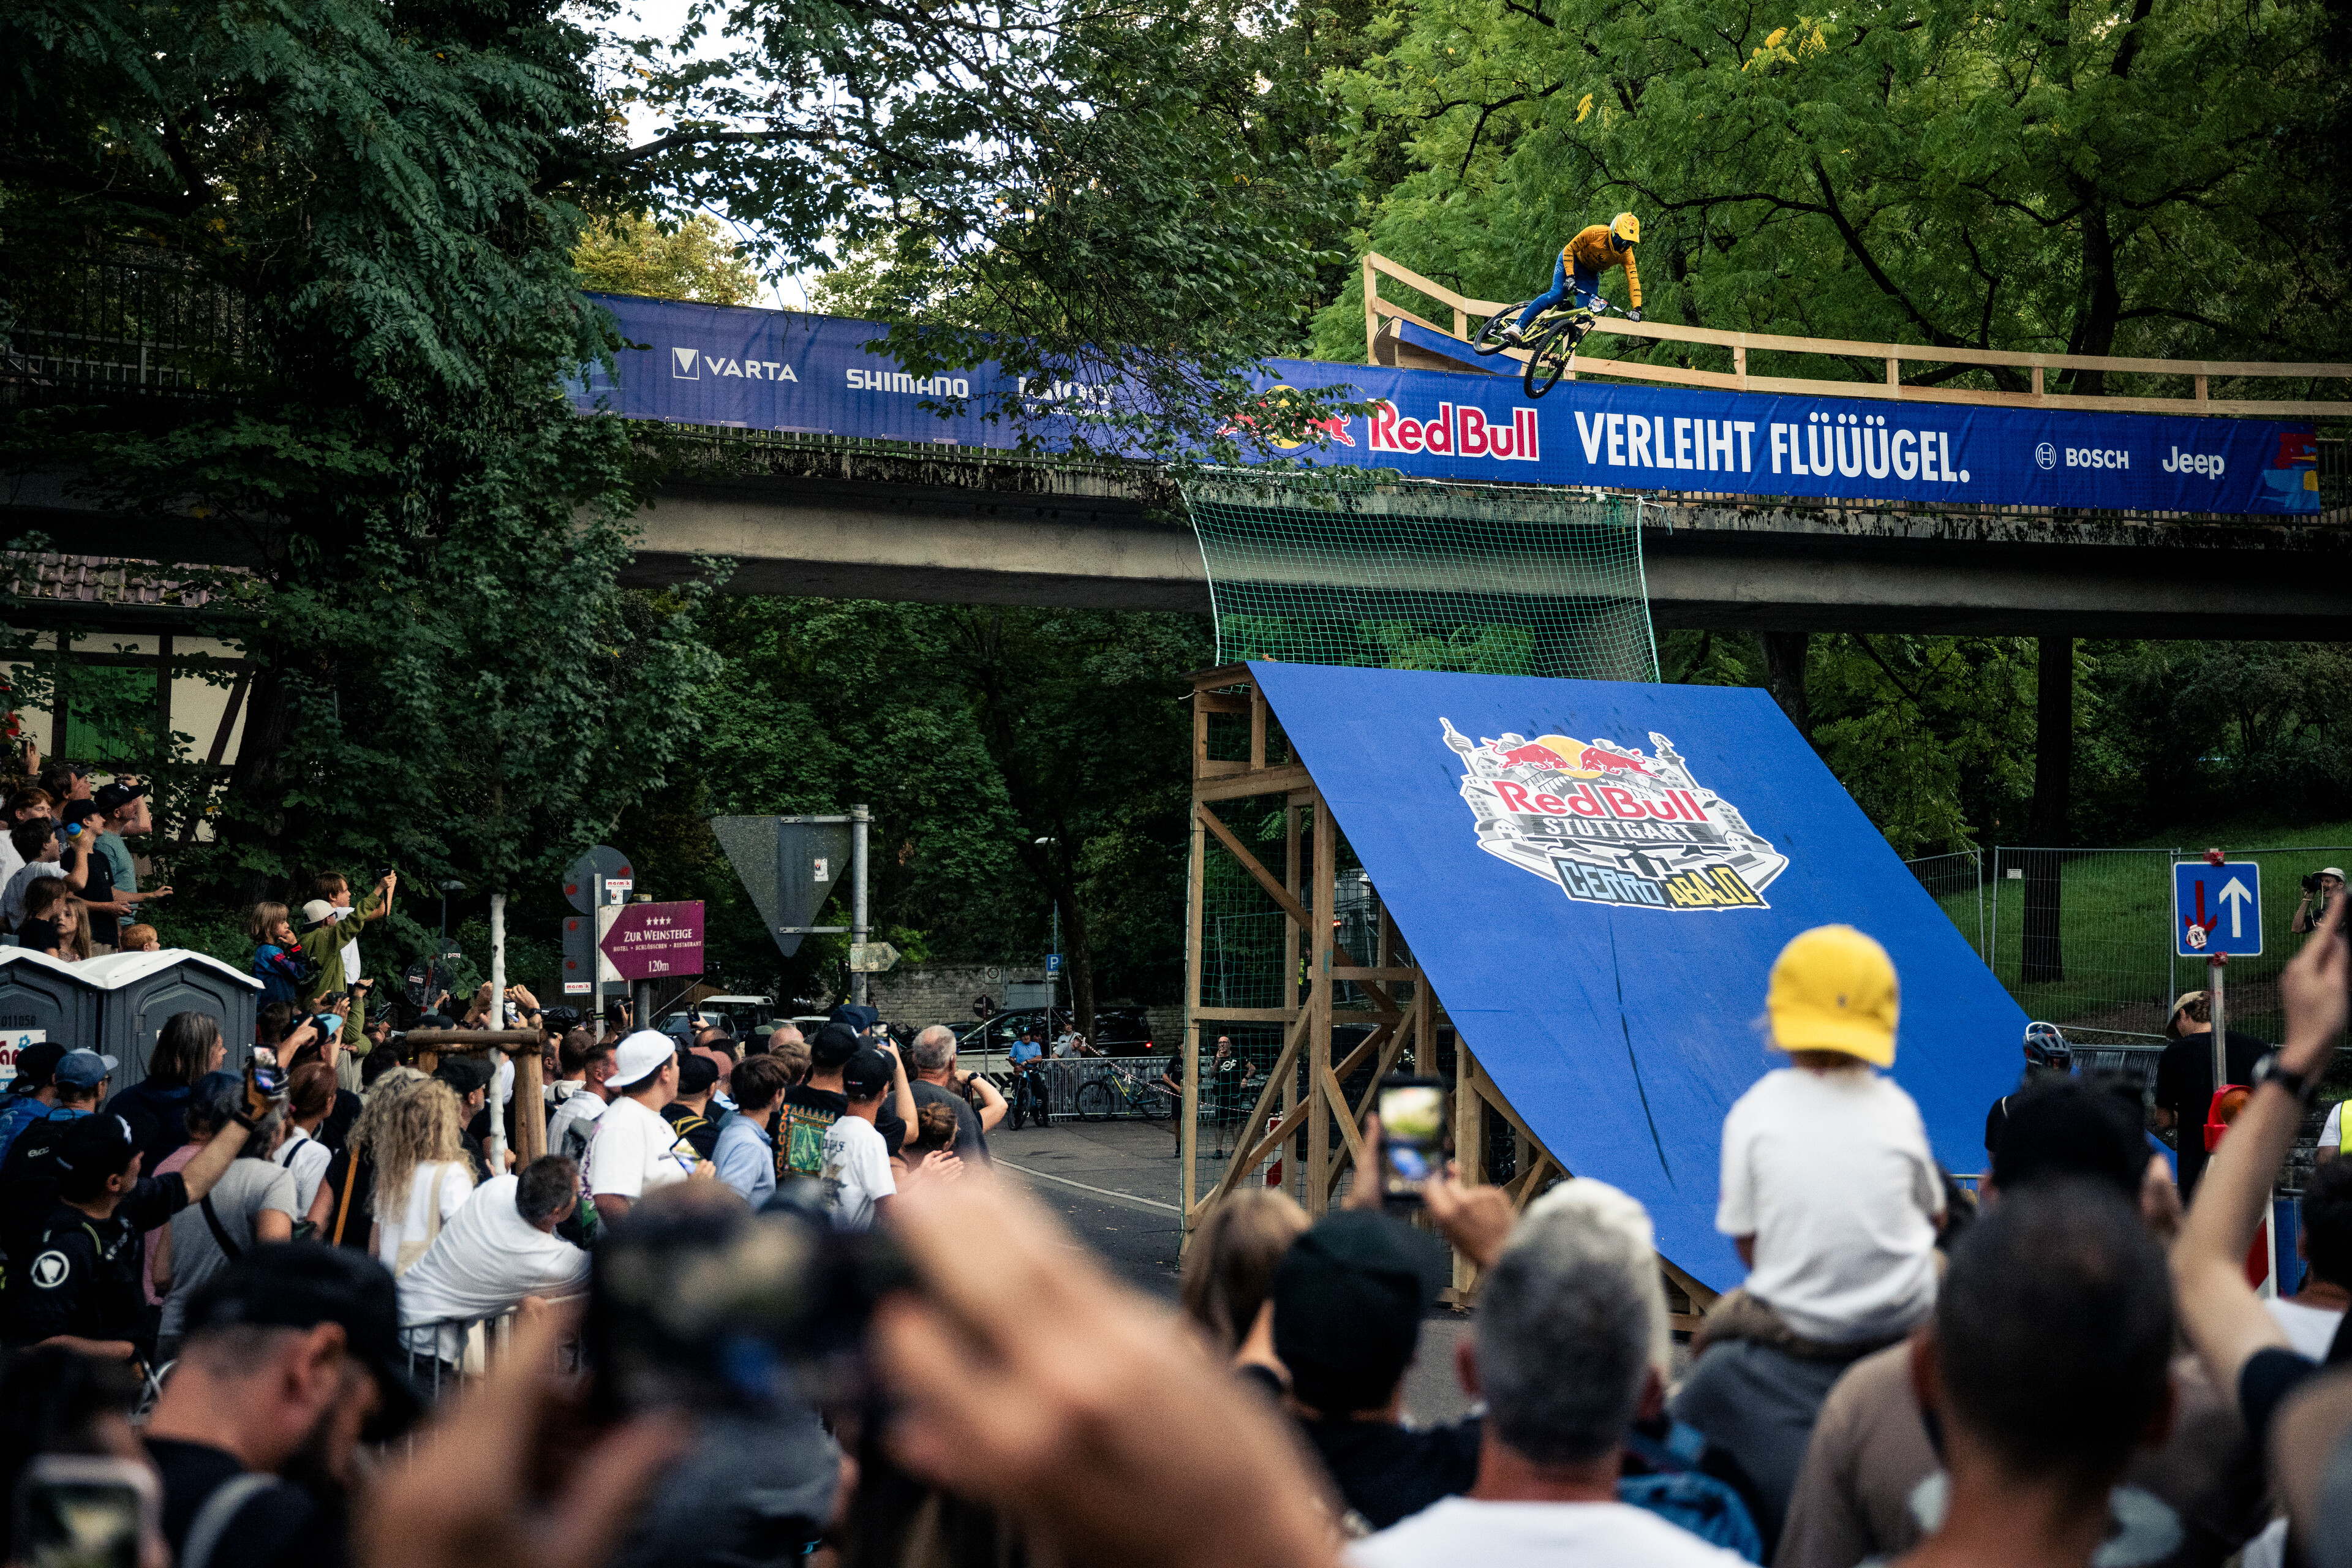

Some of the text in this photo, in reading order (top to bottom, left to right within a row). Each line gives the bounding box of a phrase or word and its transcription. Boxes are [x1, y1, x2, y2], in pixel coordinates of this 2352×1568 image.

[704, 355, 799, 382] VARTA
[846, 369, 969, 398] SHIMANO
[1368, 398, 1970, 483] Red Bull VERLEIHT FLÜÜÜGEL.
[2066, 448, 2129, 469] BOSCH
[2162, 446, 2225, 480] Jeep
[1491, 780, 1709, 822] Red Bull
[1545, 817, 1698, 843] STUTTGART
[1558, 860, 1758, 906] CERRO ABAJO
[643, 929, 692, 941] WEINSTEIGE
[648, 960, 669, 973] 120m
[1050, 956, 1059, 969] P
